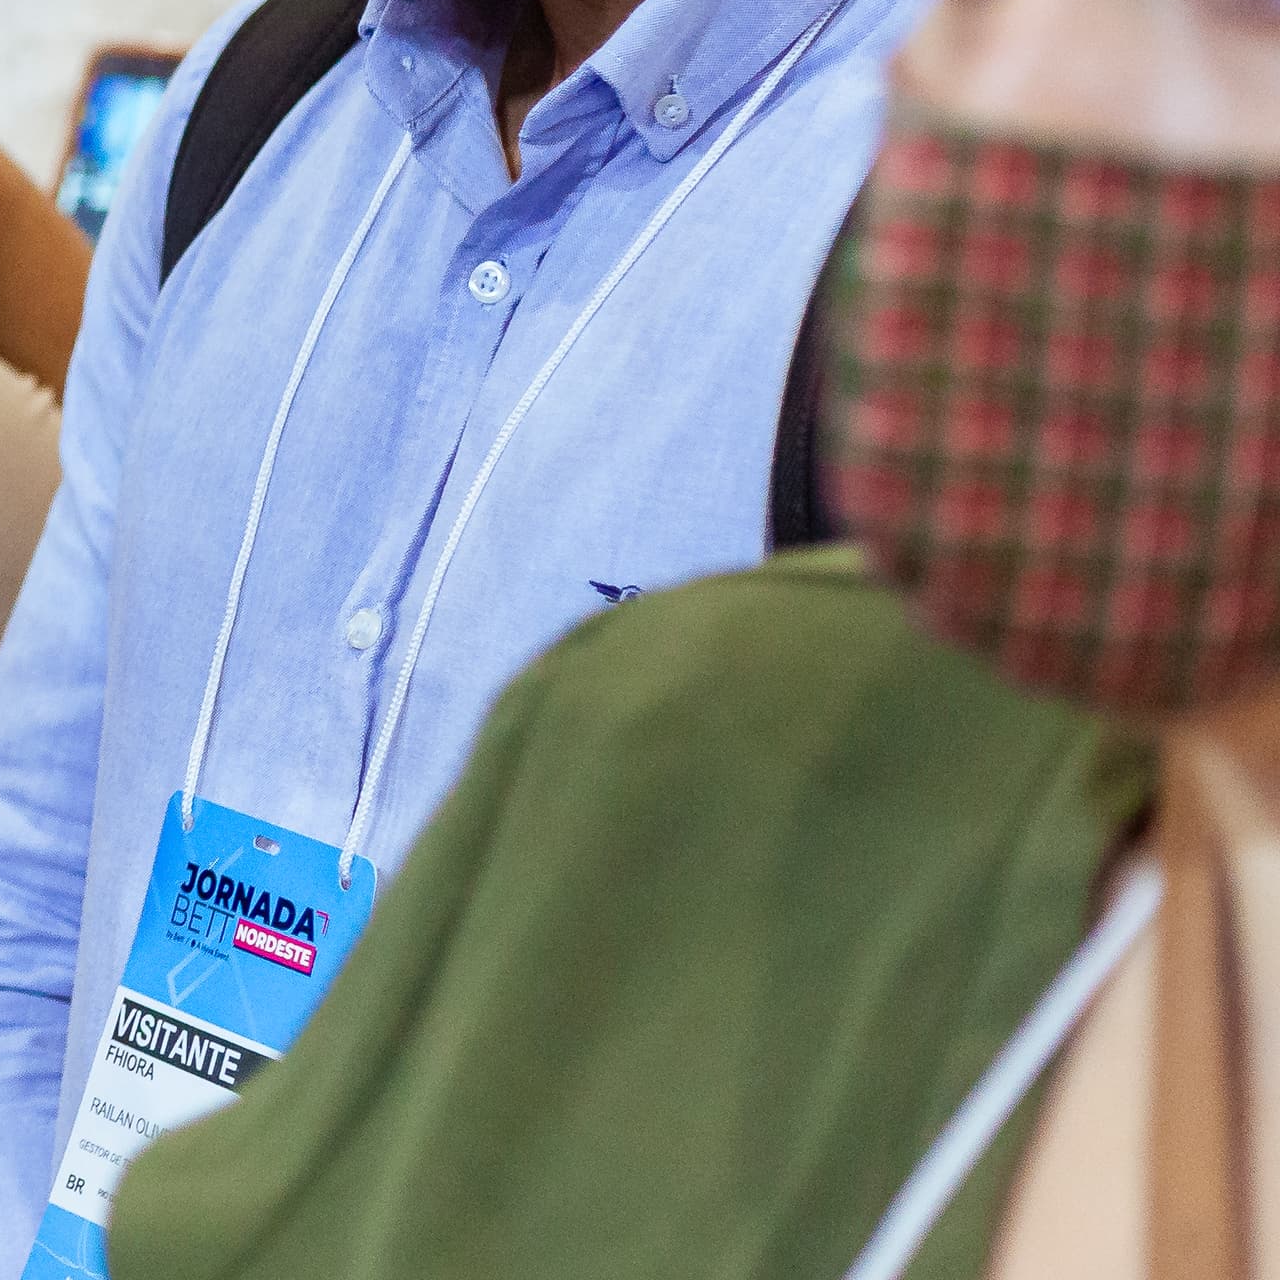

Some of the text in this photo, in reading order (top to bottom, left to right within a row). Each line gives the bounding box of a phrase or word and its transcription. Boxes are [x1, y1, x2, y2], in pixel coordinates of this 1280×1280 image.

[181, 862, 314, 942] JORNADA
[171, 893, 312, 967] BETT NORDESTE
[105, 1045, 154, 1080] FHIORA
[117, 1004, 241, 1085] VISITANTE
[90, 1097, 135, 1129] RAILAN
[66, 1174, 85, 1194] BR
